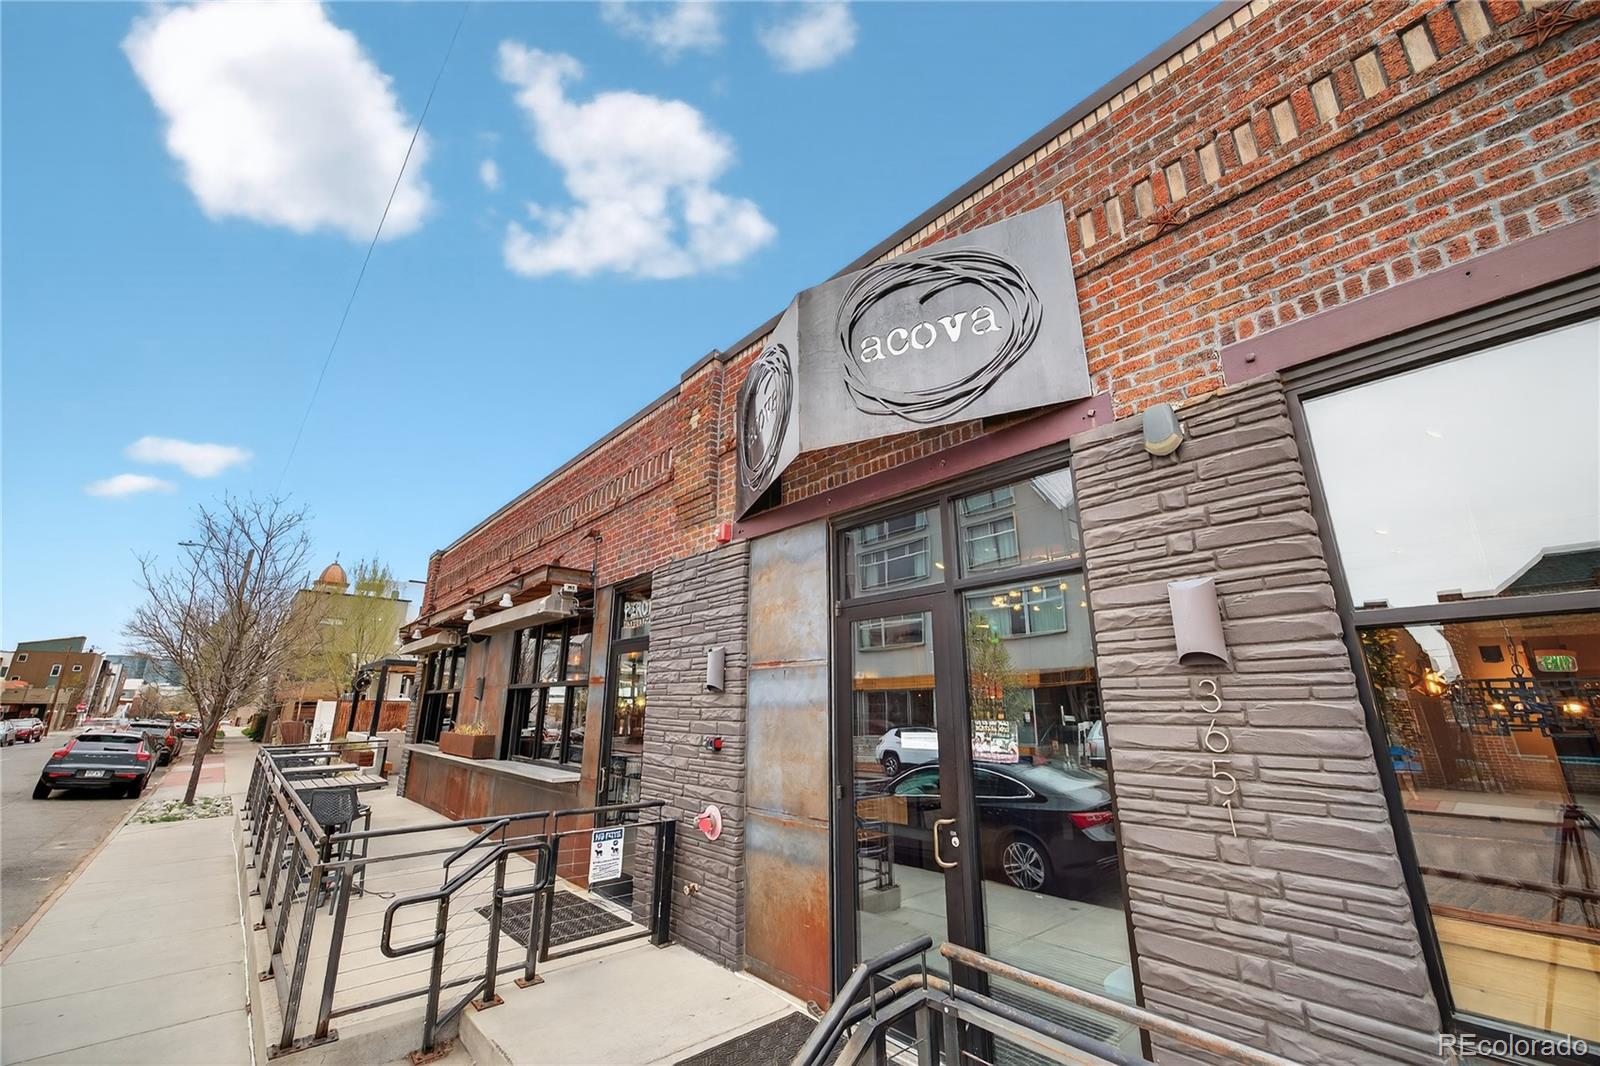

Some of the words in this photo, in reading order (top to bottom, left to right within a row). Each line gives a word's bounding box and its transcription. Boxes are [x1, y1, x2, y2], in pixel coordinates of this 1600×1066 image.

[859, 305, 1002, 364] acova
[624, 601, 651, 620] PERO
[1198, 679, 1237, 838] 3651
